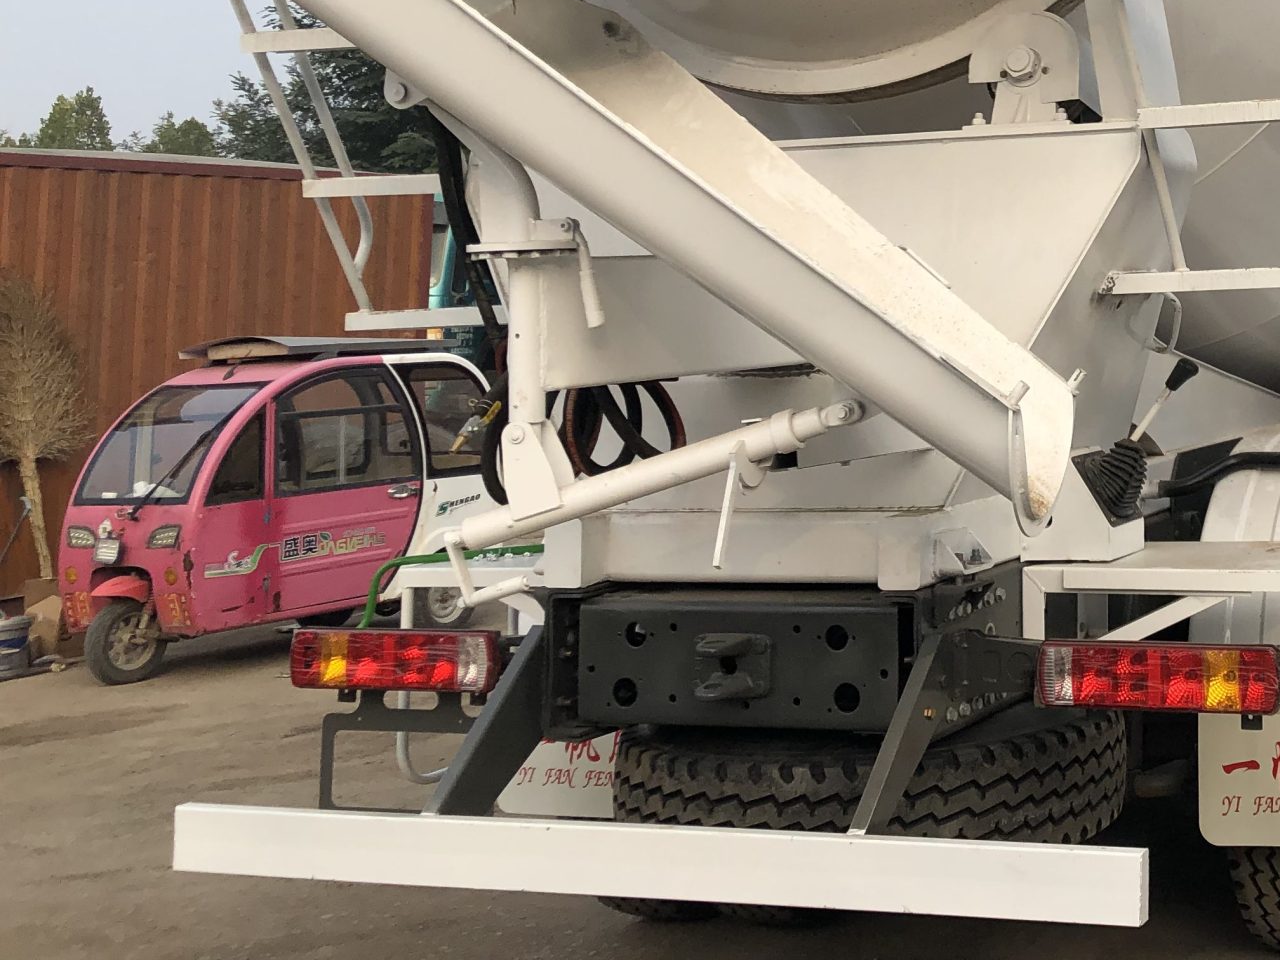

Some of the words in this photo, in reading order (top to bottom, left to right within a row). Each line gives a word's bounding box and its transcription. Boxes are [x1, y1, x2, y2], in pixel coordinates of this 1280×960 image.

[434, 493, 481, 517] SHENGAO
[283, 534, 318, 559] 盛奥
[516, 766, 536, 786] YI
[542, 767, 578, 789] FAN
[1221, 795, 1241, 817] YI
